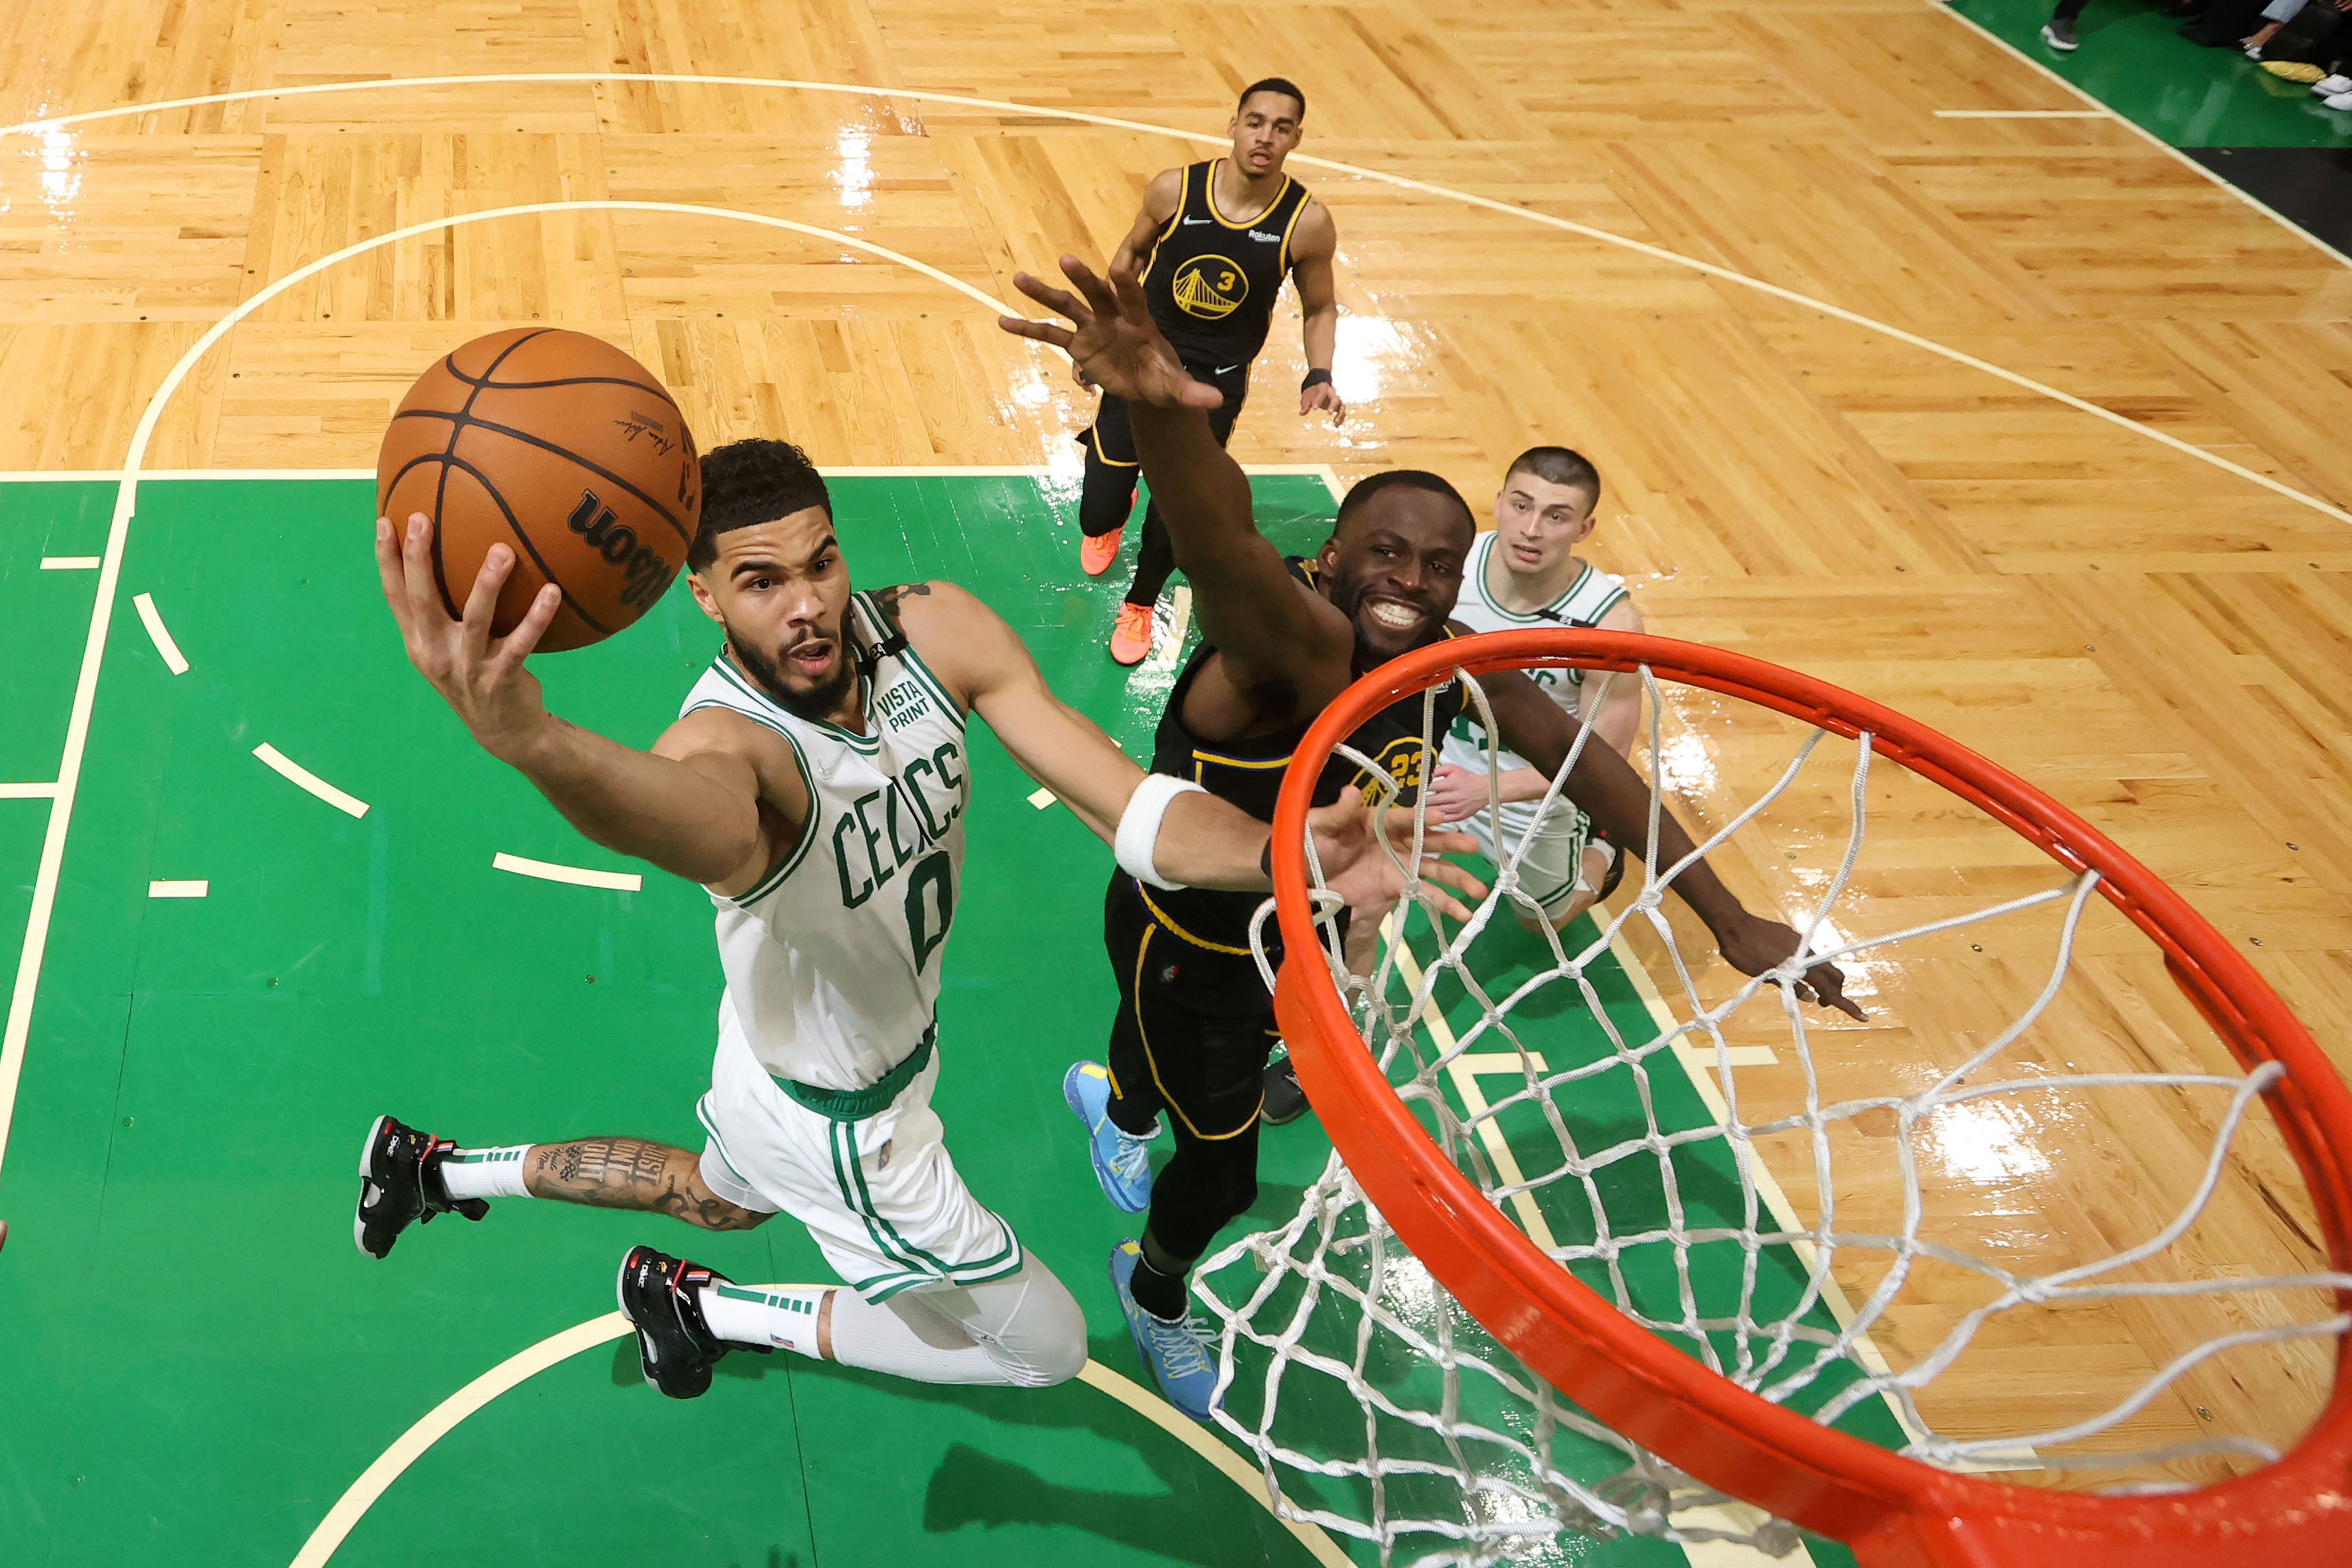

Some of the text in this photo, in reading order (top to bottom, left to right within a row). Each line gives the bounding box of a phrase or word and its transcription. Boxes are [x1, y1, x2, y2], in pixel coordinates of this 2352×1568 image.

[1248, 229, 1280, 242] Rakuten
[1217, 271, 1236, 291] 3
[877, 680, 923, 717] VISTA
[889, 697, 930, 733] PRINT
[1390, 751, 1423, 789] 23
[833, 742, 962, 910] CELICS
[904, 851, 952, 977] 0
